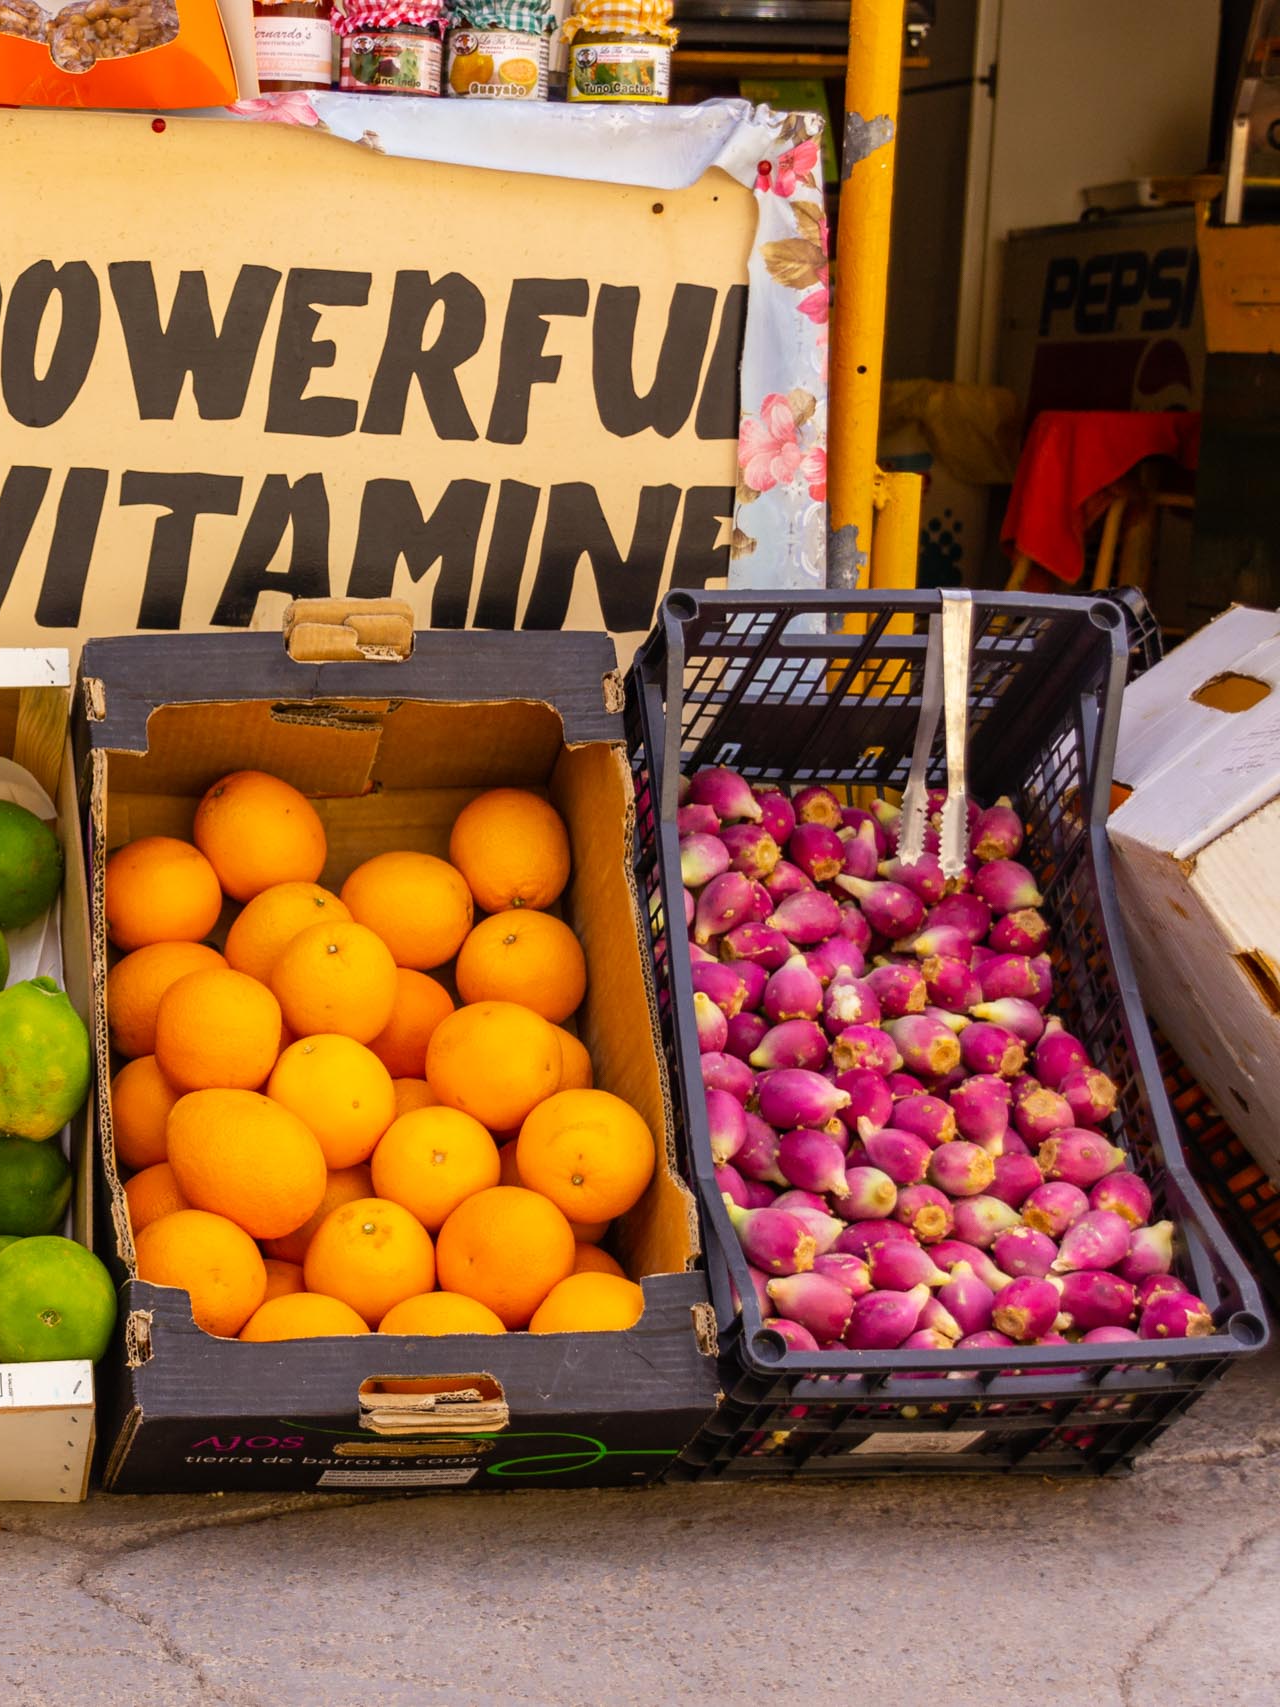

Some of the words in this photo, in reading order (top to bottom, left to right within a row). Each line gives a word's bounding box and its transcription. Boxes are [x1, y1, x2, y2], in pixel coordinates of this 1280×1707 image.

[254, 26, 312, 40] ernardo's
[470, 82, 525, 96] Guayabo
[585, 83, 609, 93] Tuno
[613, 82, 650, 93] Cactus
[1039, 248, 1199, 336] PEPSI
[191, 1435, 305, 1452] AJOS
[185, 1456, 253, 1464] tierra
[262, 1456, 293, 1464] de
[302, 1457, 381, 1465] barros
[416, 1457, 483, 1465] coop.
